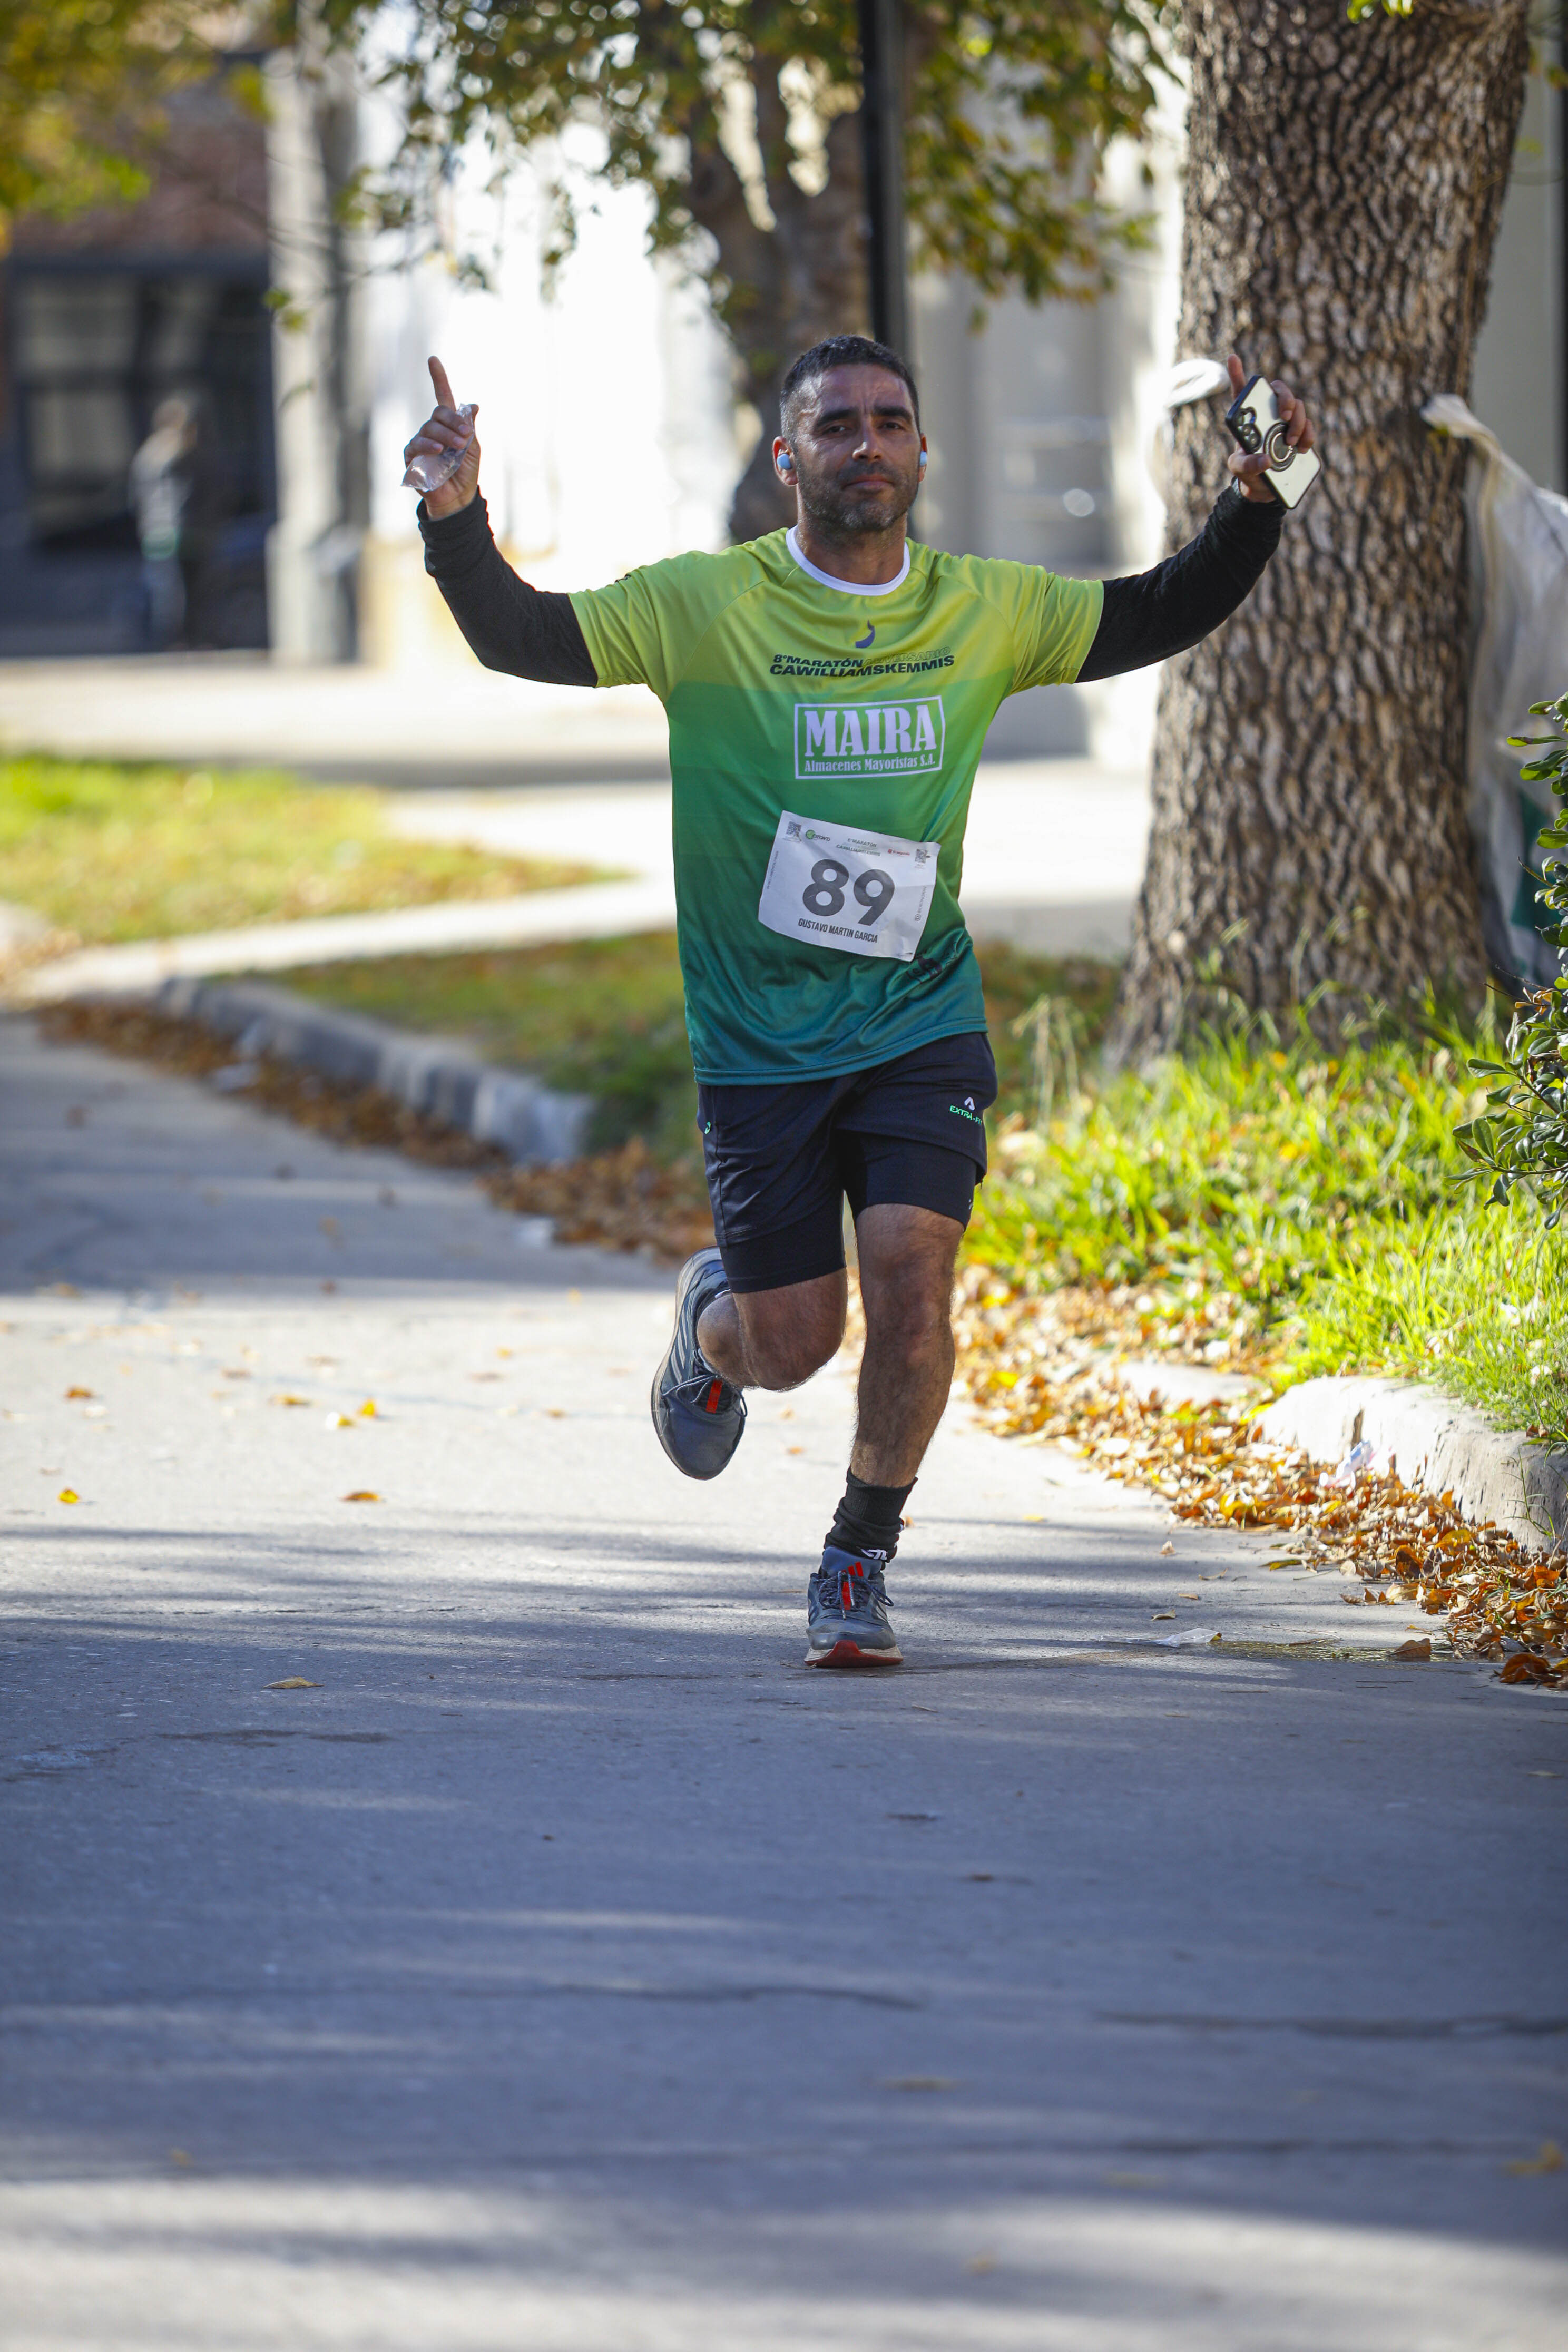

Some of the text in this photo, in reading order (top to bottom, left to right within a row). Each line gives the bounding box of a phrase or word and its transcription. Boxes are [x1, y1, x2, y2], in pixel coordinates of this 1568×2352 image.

[770, 655, 955, 677] CAWILLIAMSKEMMIS
[804, 704, 937, 757] MAIRA
[805, 753, 936, 772] Almacenes Mayoristas S.A.
[802, 859, 895, 926] 89
[798, 918, 878, 943] GUSTAVO MARTIN GARCIA
